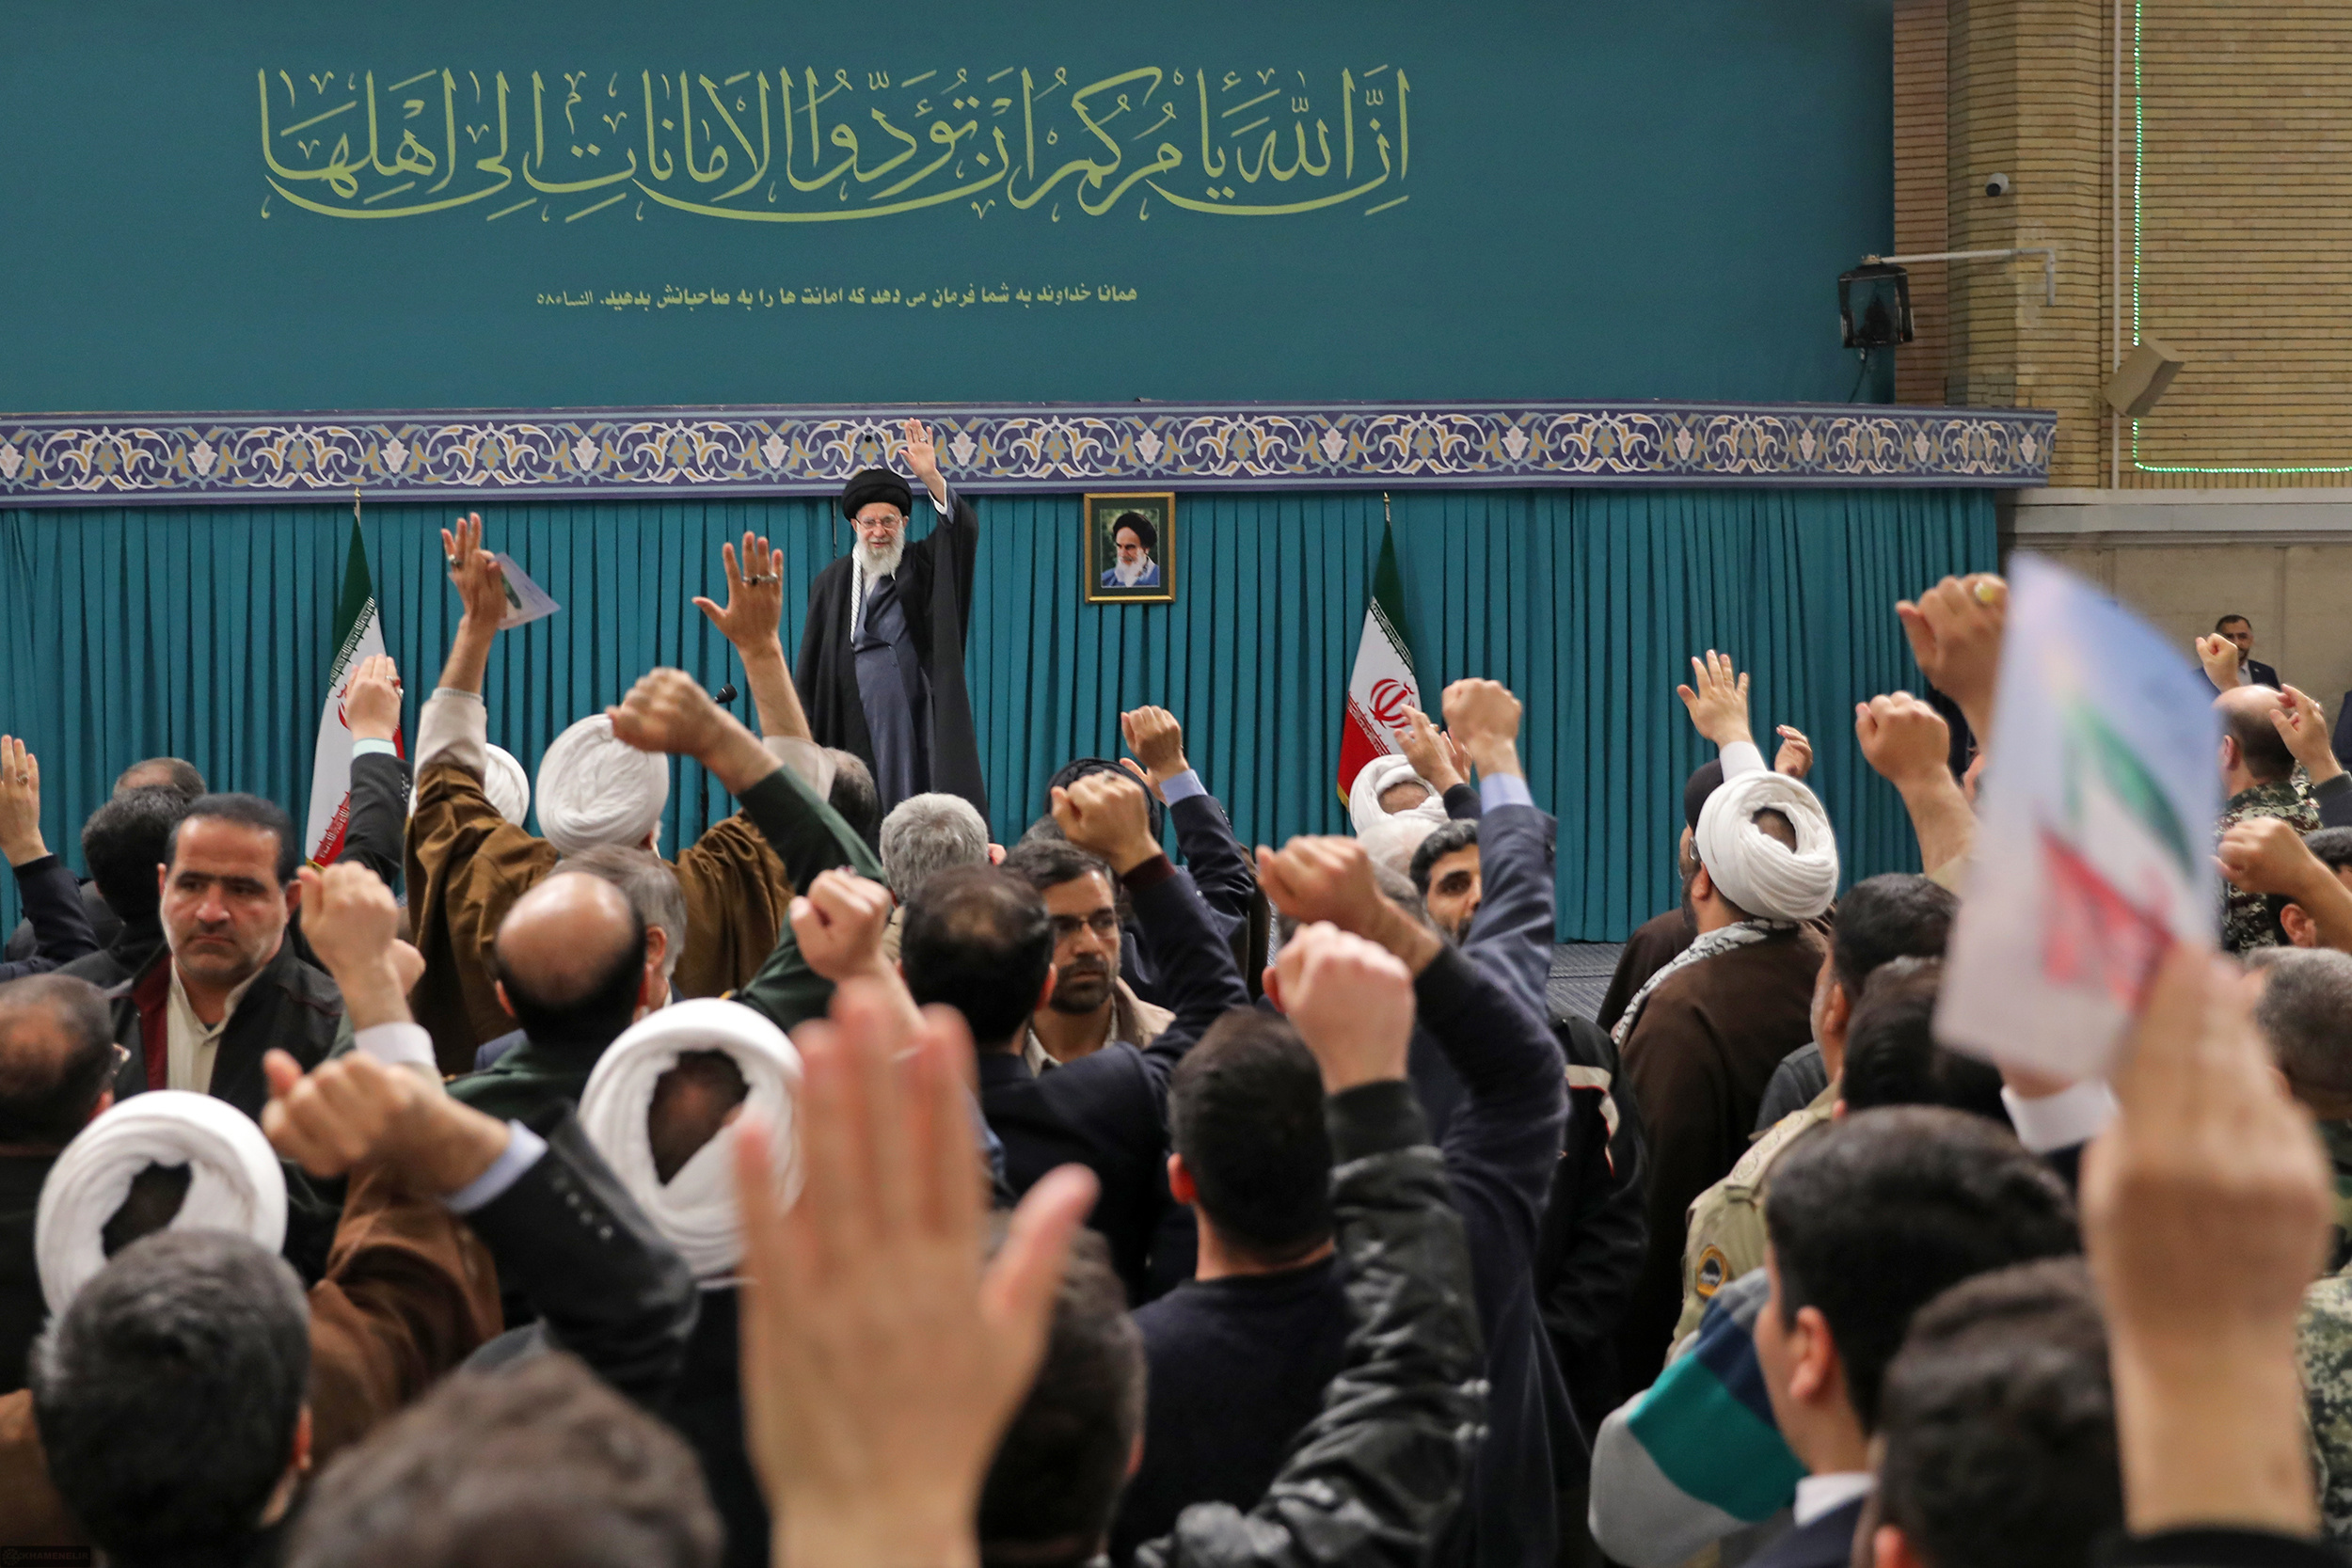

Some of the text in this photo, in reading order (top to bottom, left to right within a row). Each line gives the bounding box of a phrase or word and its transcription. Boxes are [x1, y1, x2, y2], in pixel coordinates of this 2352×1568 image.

[657, 284, 731, 310] صاحبانش
[737, 290, 754, 309] به
[759, 290, 774, 308] را
[779, 288, 797, 305] ها
[801, 288, 844, 305] امانت
[848, 287, 866, 304] که
[870, 289, 901, 304] دهد
[931, 284, 976, 309] فرمان
[981, 284, 1009, 303] شما
[1015, 289, 1032, 308] به
[1036, 283, 1091, 305] خداوند
[1098, 286, 1137, 302] همانا
